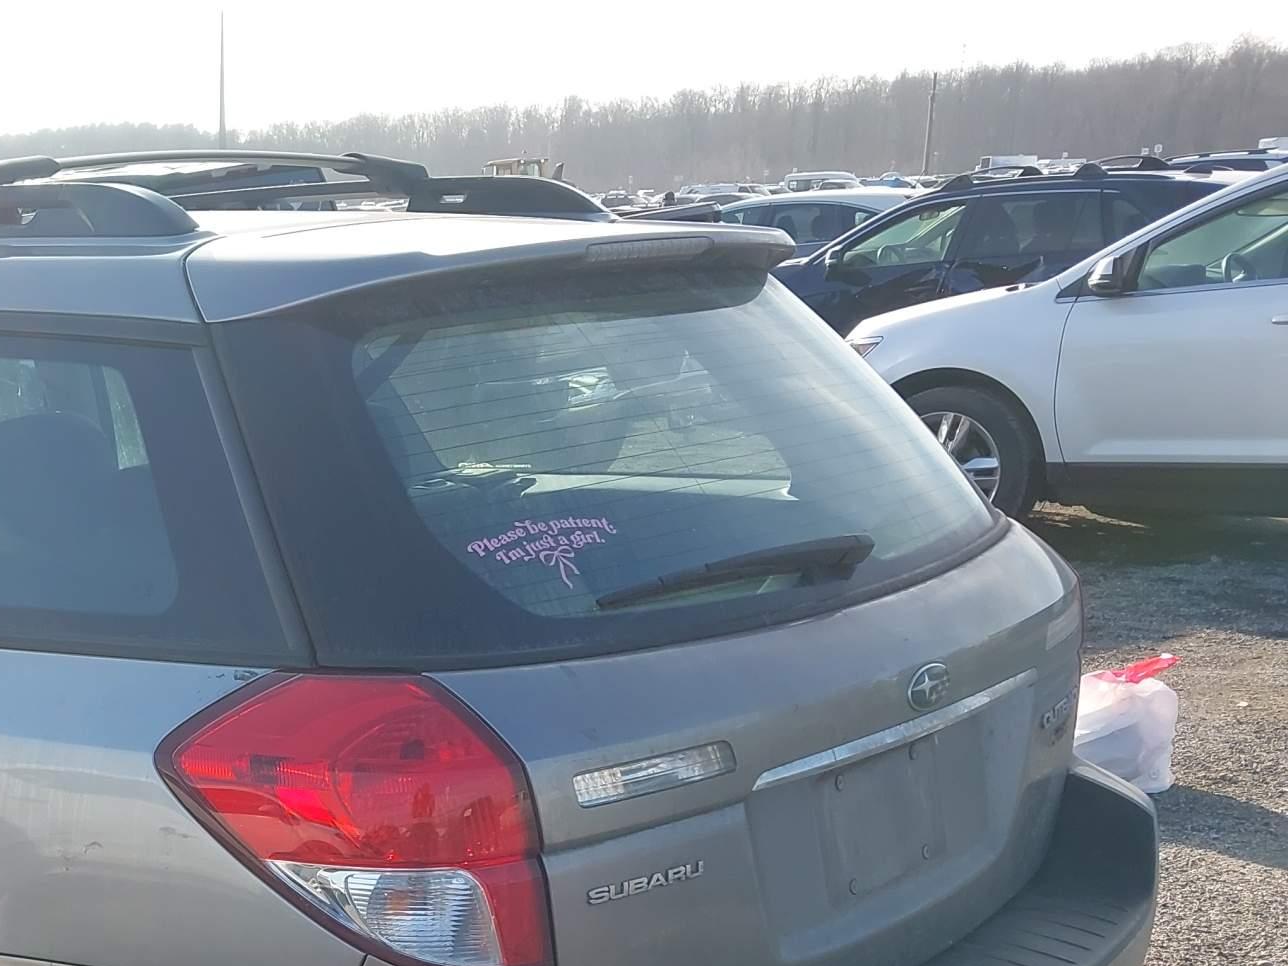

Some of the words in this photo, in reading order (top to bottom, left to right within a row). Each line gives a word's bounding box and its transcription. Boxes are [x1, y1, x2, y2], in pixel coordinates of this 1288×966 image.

[467, 527, 527, 557] Please
[514, 519, 548, 535] be
[495, 548, 526, 565] I'm
[522, 534, 556, 562] just
[558, 535, 569, 546] a
[570, 530, 606, 549] girl.
[587, 860, 704, 905] SUBARU
